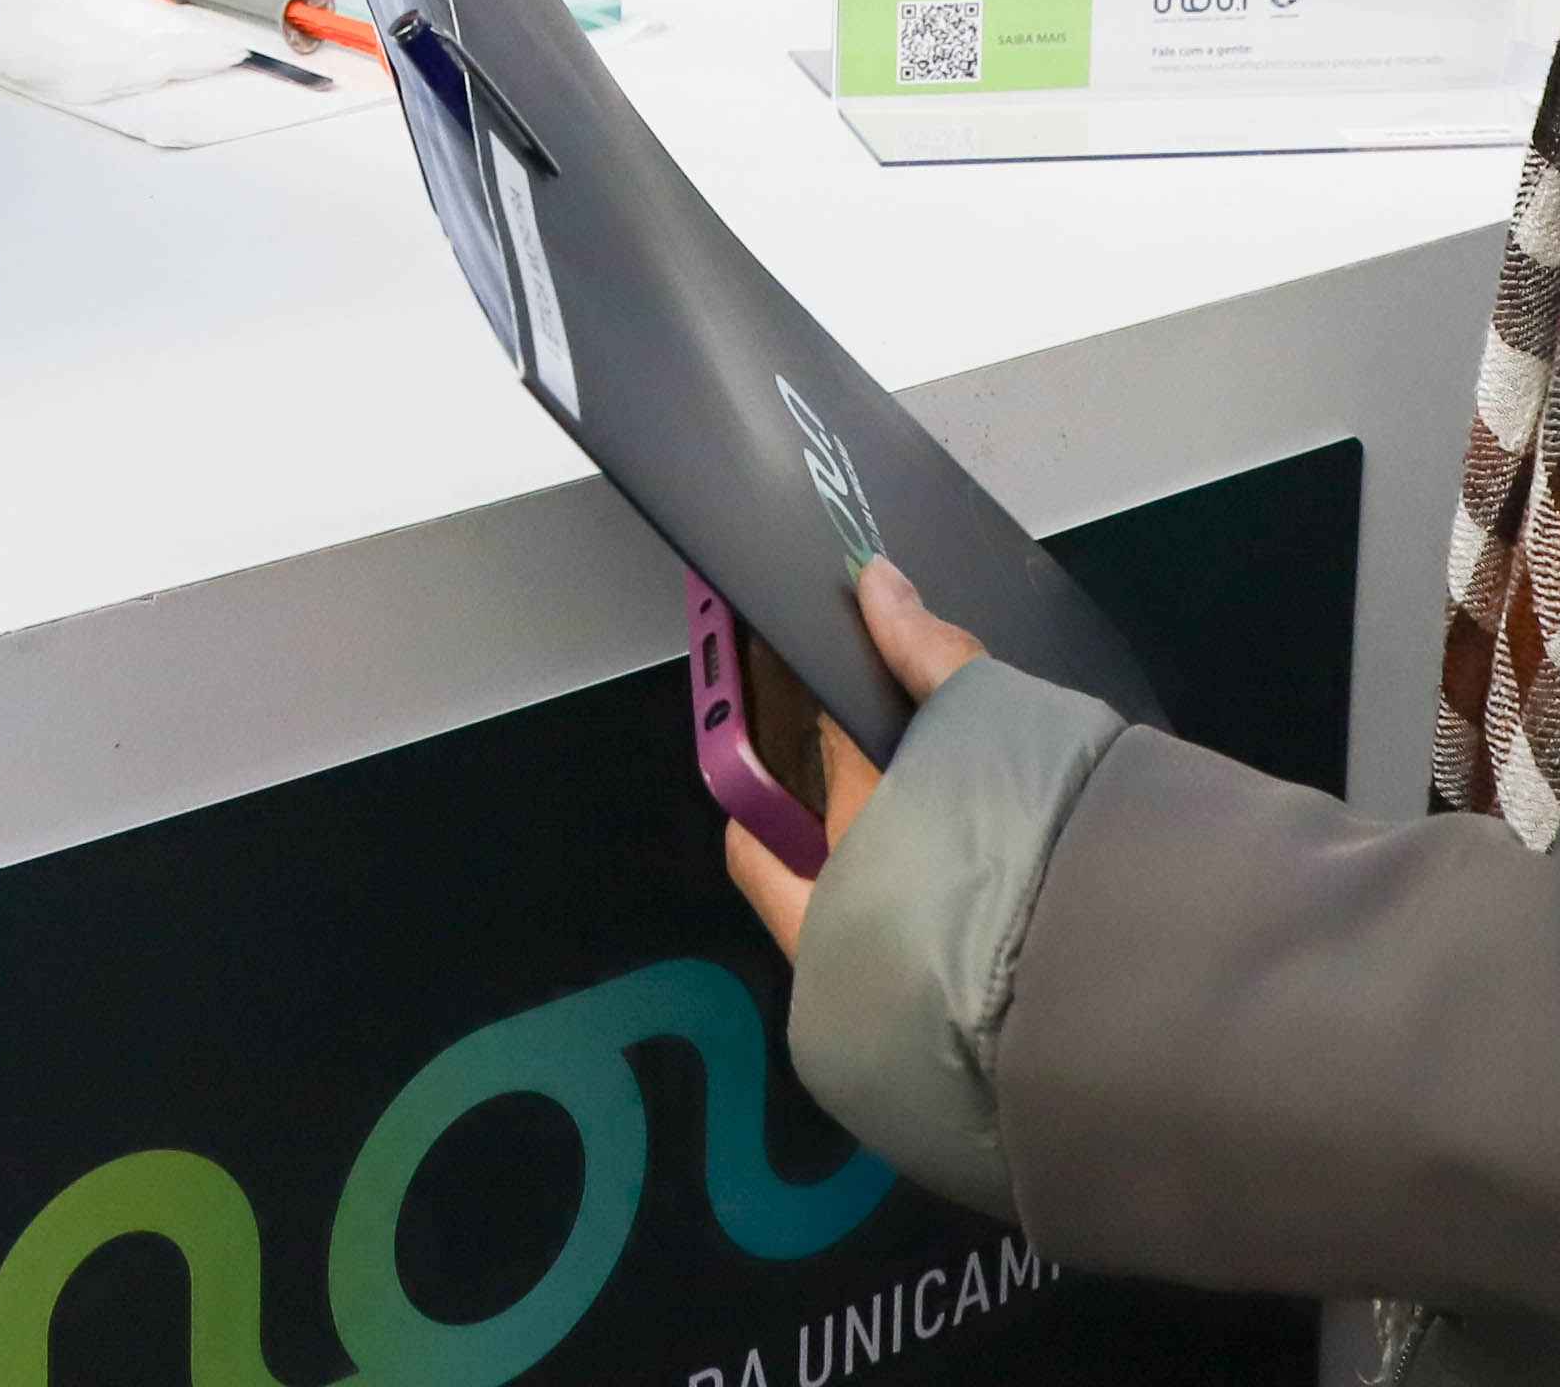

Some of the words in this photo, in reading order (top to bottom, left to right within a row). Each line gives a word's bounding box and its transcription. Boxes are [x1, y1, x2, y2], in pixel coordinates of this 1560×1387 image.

[997, 33, 1033, 45] SAIBA
[1035, 31, 1066, 44] MAIS
[798, 1236, 1060, 1387] UNICAM
